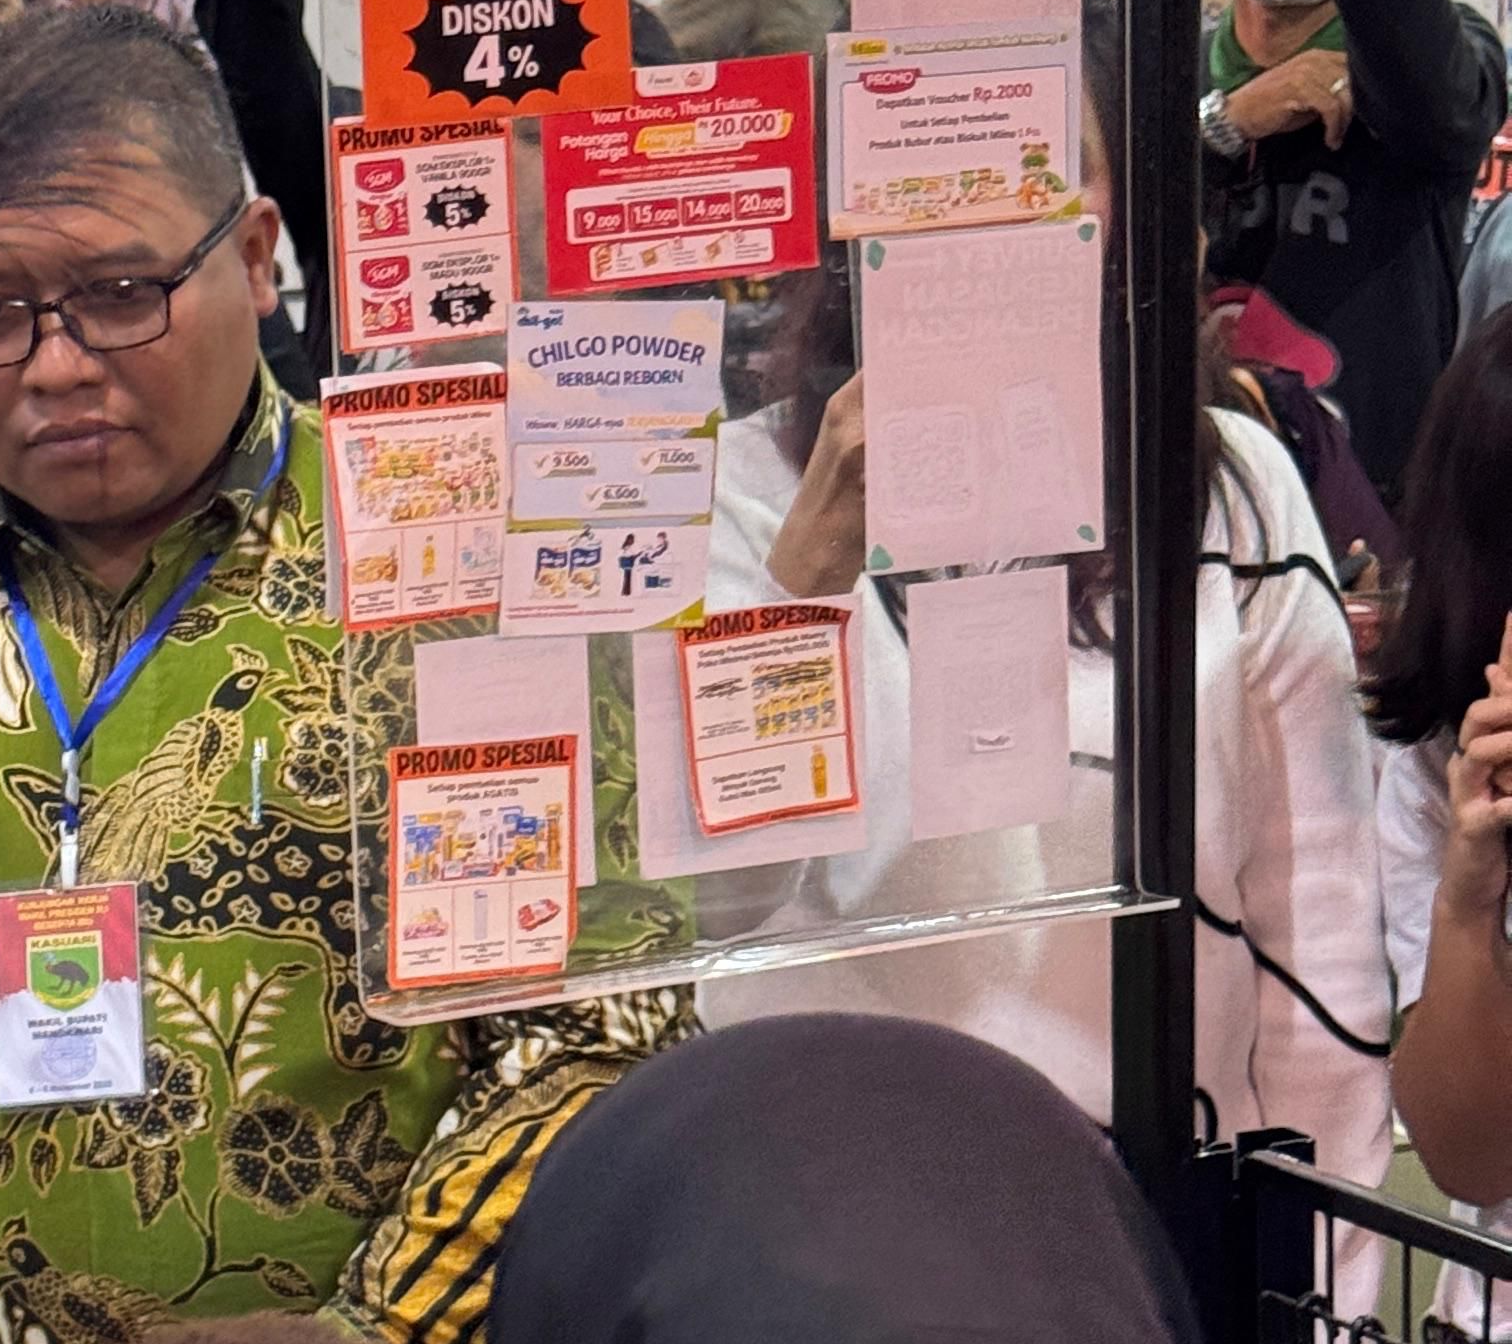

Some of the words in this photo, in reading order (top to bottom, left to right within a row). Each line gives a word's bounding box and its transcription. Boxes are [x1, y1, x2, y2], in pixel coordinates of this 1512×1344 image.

[463, 34, 540, 89] 4%
[866, 72, 914, 88] PROMO
[928, 93, 970, 106] Voucher
[973, 83, 1033, 103] Rp.2000
[591, 110, 622, 126] Your
[625, 105, 677, 123] Choice,
[678, 99, 713, 116] Their
[711, 114, 776, 137] 20.000
[559, 131, 629, 150] Potongan
[584, 145, 629, 164] Harga
[445, 203, 473, 226] 5%
[450, 300, 476, 323] 5%
[527, 335, 606, 369] CHILGO
[611, 335, 706, 366] POWDER
[556, 370, 621, 388] BERBAGI
[623, 369, 685, 386] REBORN
[328, 385, 410, 416] PROMO
[417, 373, 506, 406] SPESIAL
[760, 606, 841, 630] SPESIAL
[397, 747, 476, 777] PROMO
[481, 739, 569, 768] SPESIAL
